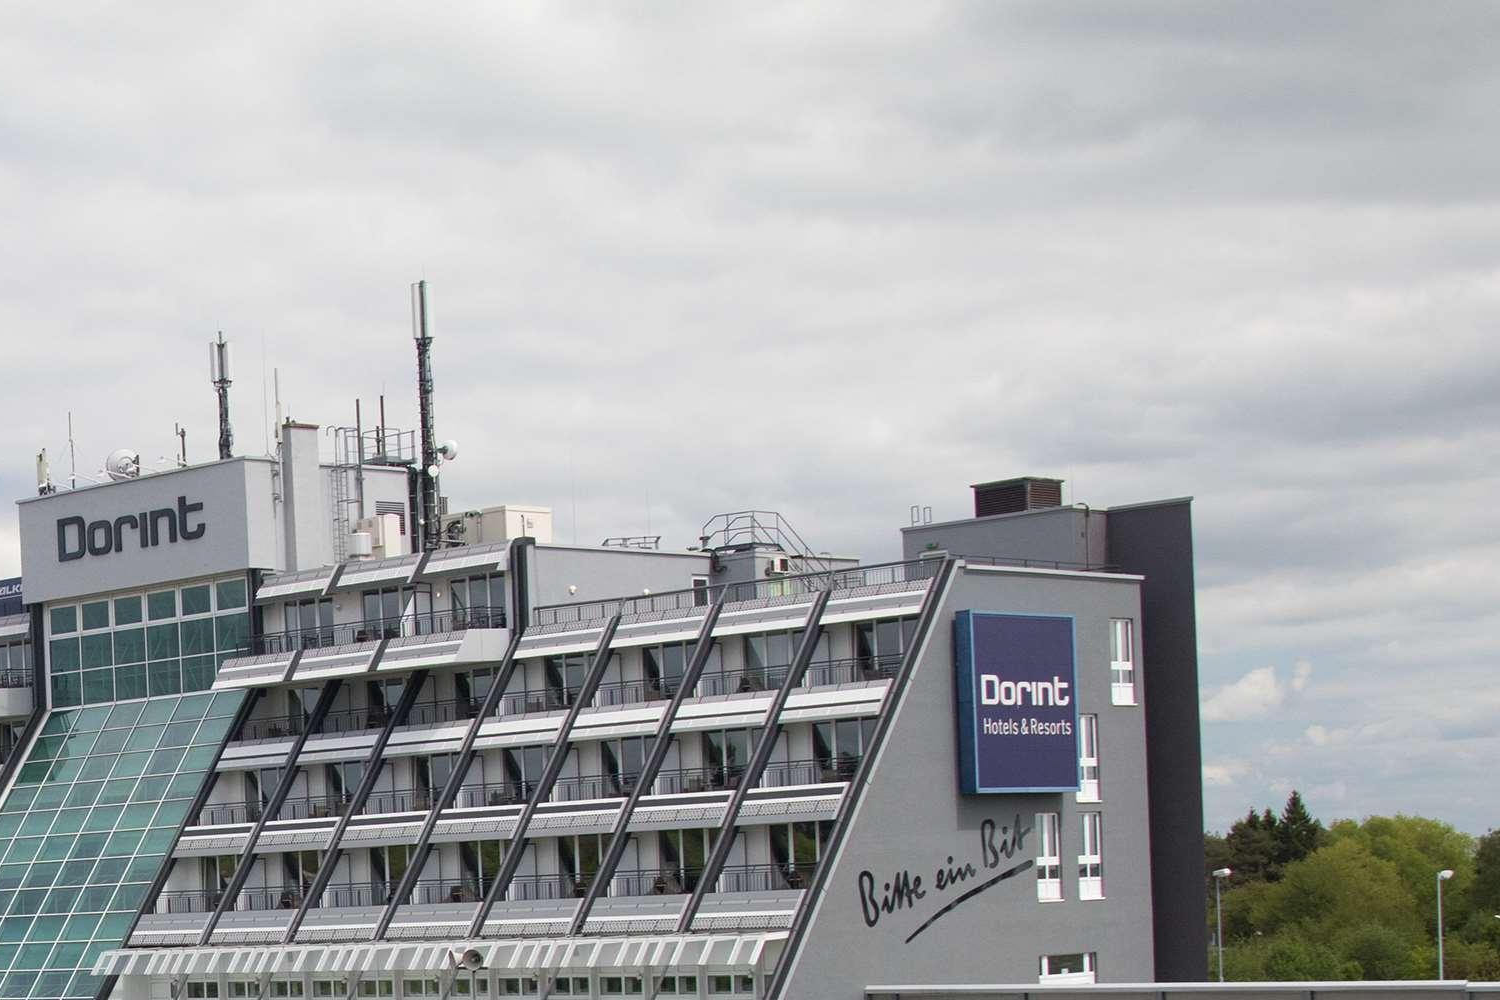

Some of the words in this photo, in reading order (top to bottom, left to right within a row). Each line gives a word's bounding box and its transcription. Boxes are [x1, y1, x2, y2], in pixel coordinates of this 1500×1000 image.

[57, 495, 206, 562] Dorint
[980, 674, 1070, 706] Dorint
[983, 717, 1019, 735] Hotels
[1020, 717, 1029, 735] &
[1030, 717, 1072, 735] Resorts
[858, 870, 927, 929] Bitte
[936, 855, 977, 891] ein
[981, 814, 1032, 869] Bit
